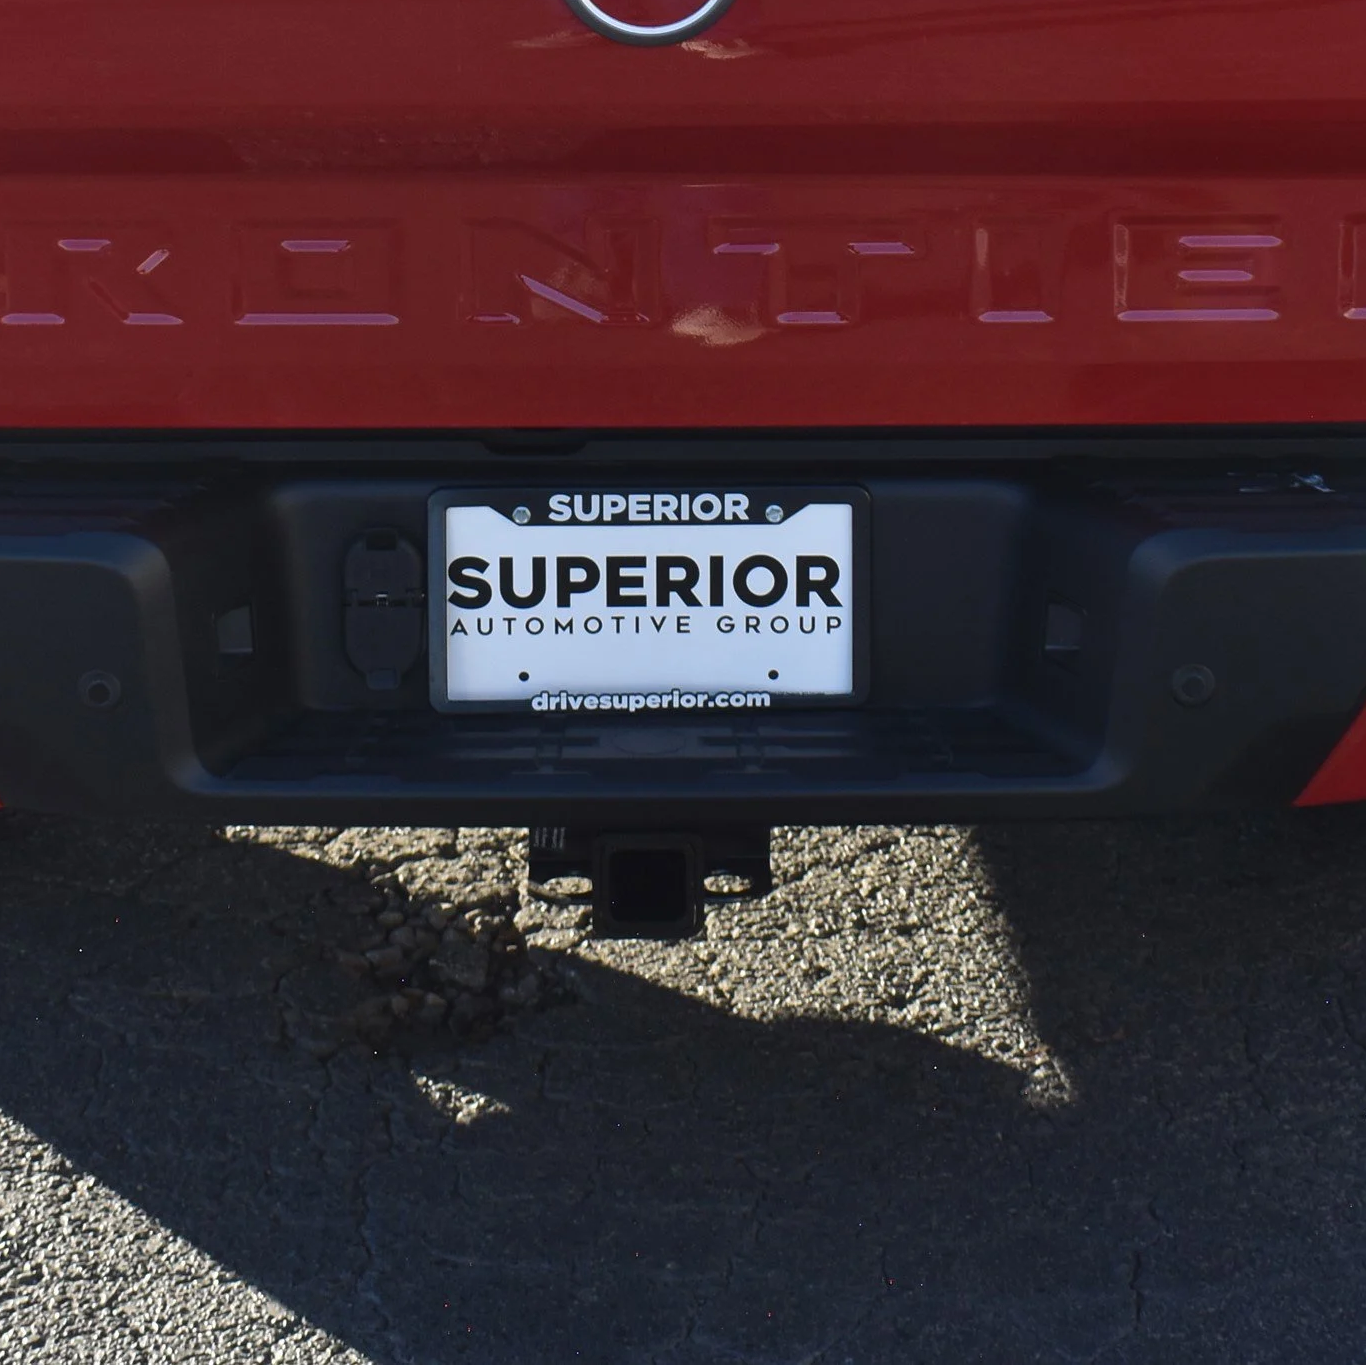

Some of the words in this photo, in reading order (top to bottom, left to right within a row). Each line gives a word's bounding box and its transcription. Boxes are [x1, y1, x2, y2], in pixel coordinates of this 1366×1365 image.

[547, 492, 750, 523] SUPERIOR
[446, 553, 844, 610] SUPERIOR
[449, 614, 693, 637] AUTOMOTIVE
[715, 614, 843, 635] GROUP
[530, 689, 772, 713] drivesuperior.com
